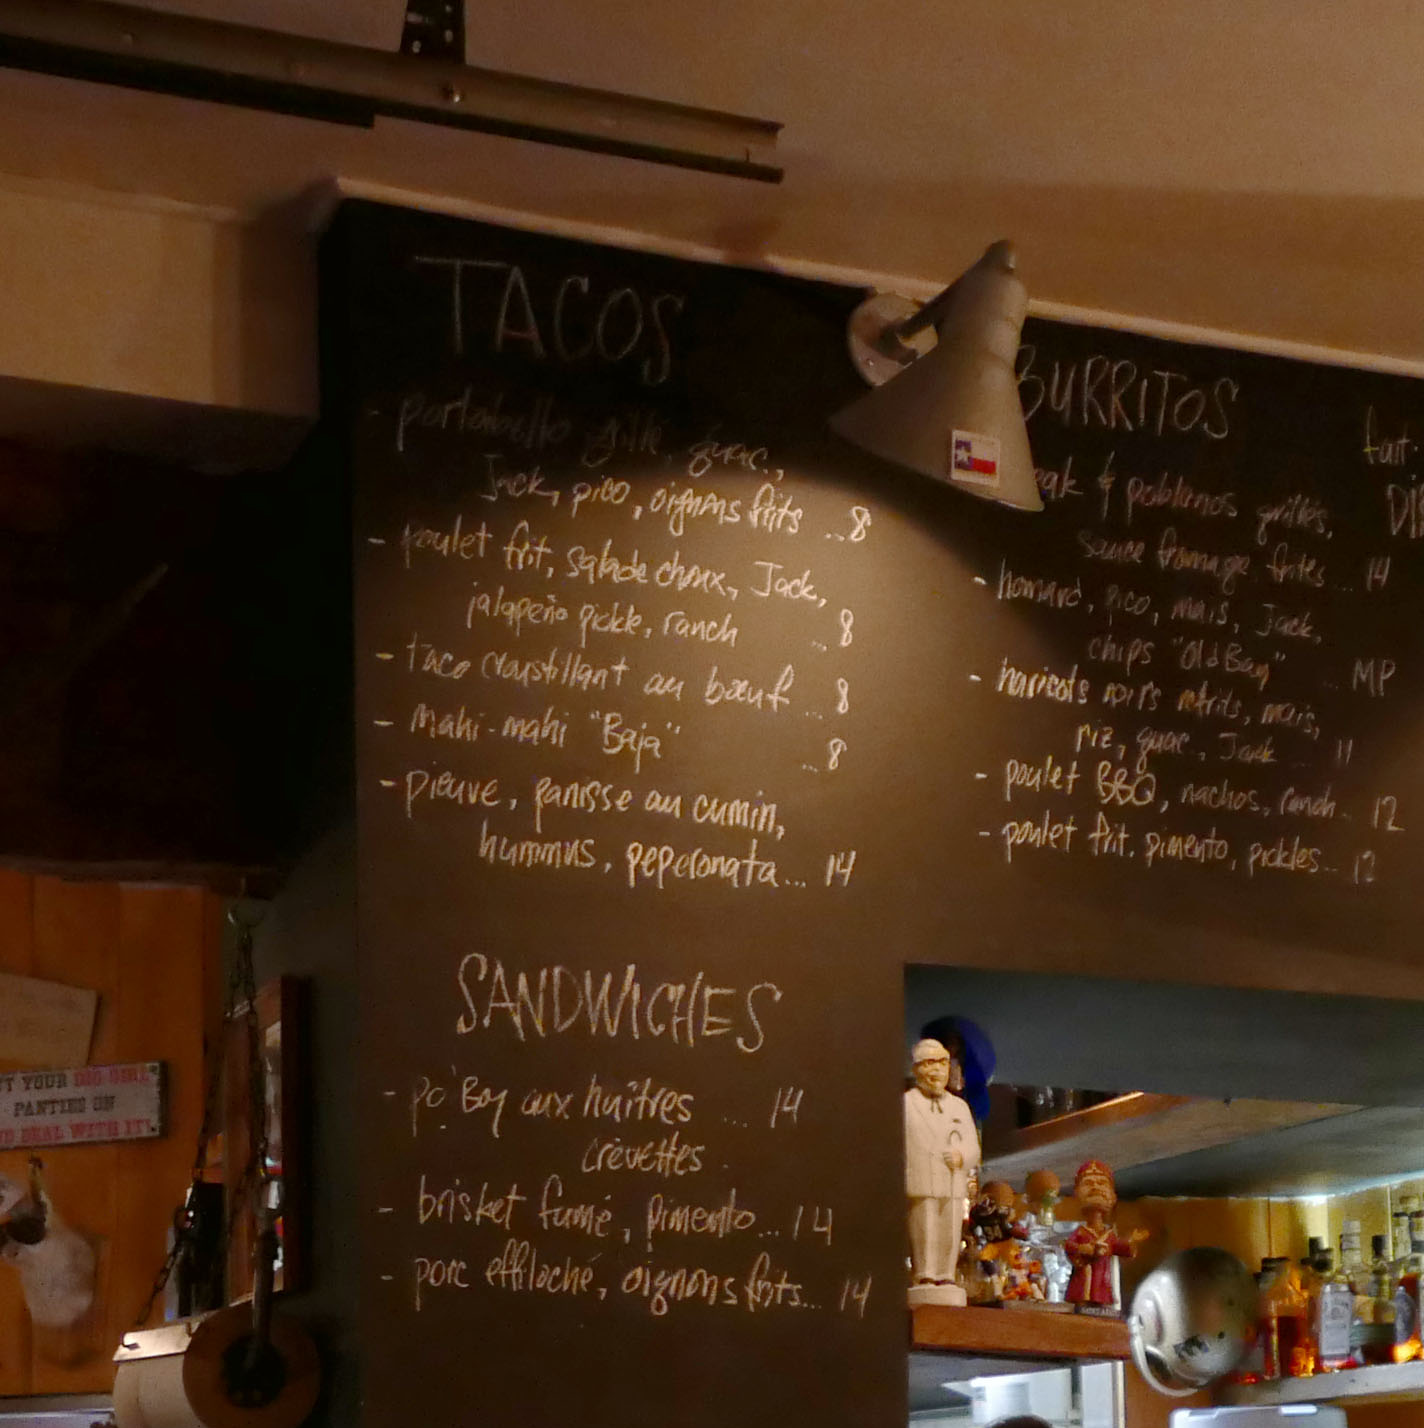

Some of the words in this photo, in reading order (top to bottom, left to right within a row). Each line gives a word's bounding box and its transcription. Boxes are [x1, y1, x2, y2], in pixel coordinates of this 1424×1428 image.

[415, 255, 686, 386] TACOS
[565, 540, 649, 588] salade
[662, 610, 739, 648] ranch
[839, 607, 856, 649] 8
[407, 631, 470, 681] taco
[833, 676, 851, 717] 8
[1087, 637, 1152, 679] chips
[1352, 658, 1397, 698] MP
[826, 736, 849, 772] 8
[533, 772, 634, 835] panisse
[1002, 754, 1081, 804] poulet
[1371, 796, 1408, 833] 12
[1000, 808, 1078, 864] poulet
[824, 847, 859, 889] 14
[455, 951, 785, 1056] SANDWICHES
[23, 1072, 69, 1092] YOUR
[768, 1084, 804, 1130] 14
[418, 1172, 527, 1232] brisket
[791, 1203, 834, 1248] 14
[414, 1254, 472, 1313] porc
[619, 1259, 738, 1317] oignons
[840, 1275, 873, 1321] 14
